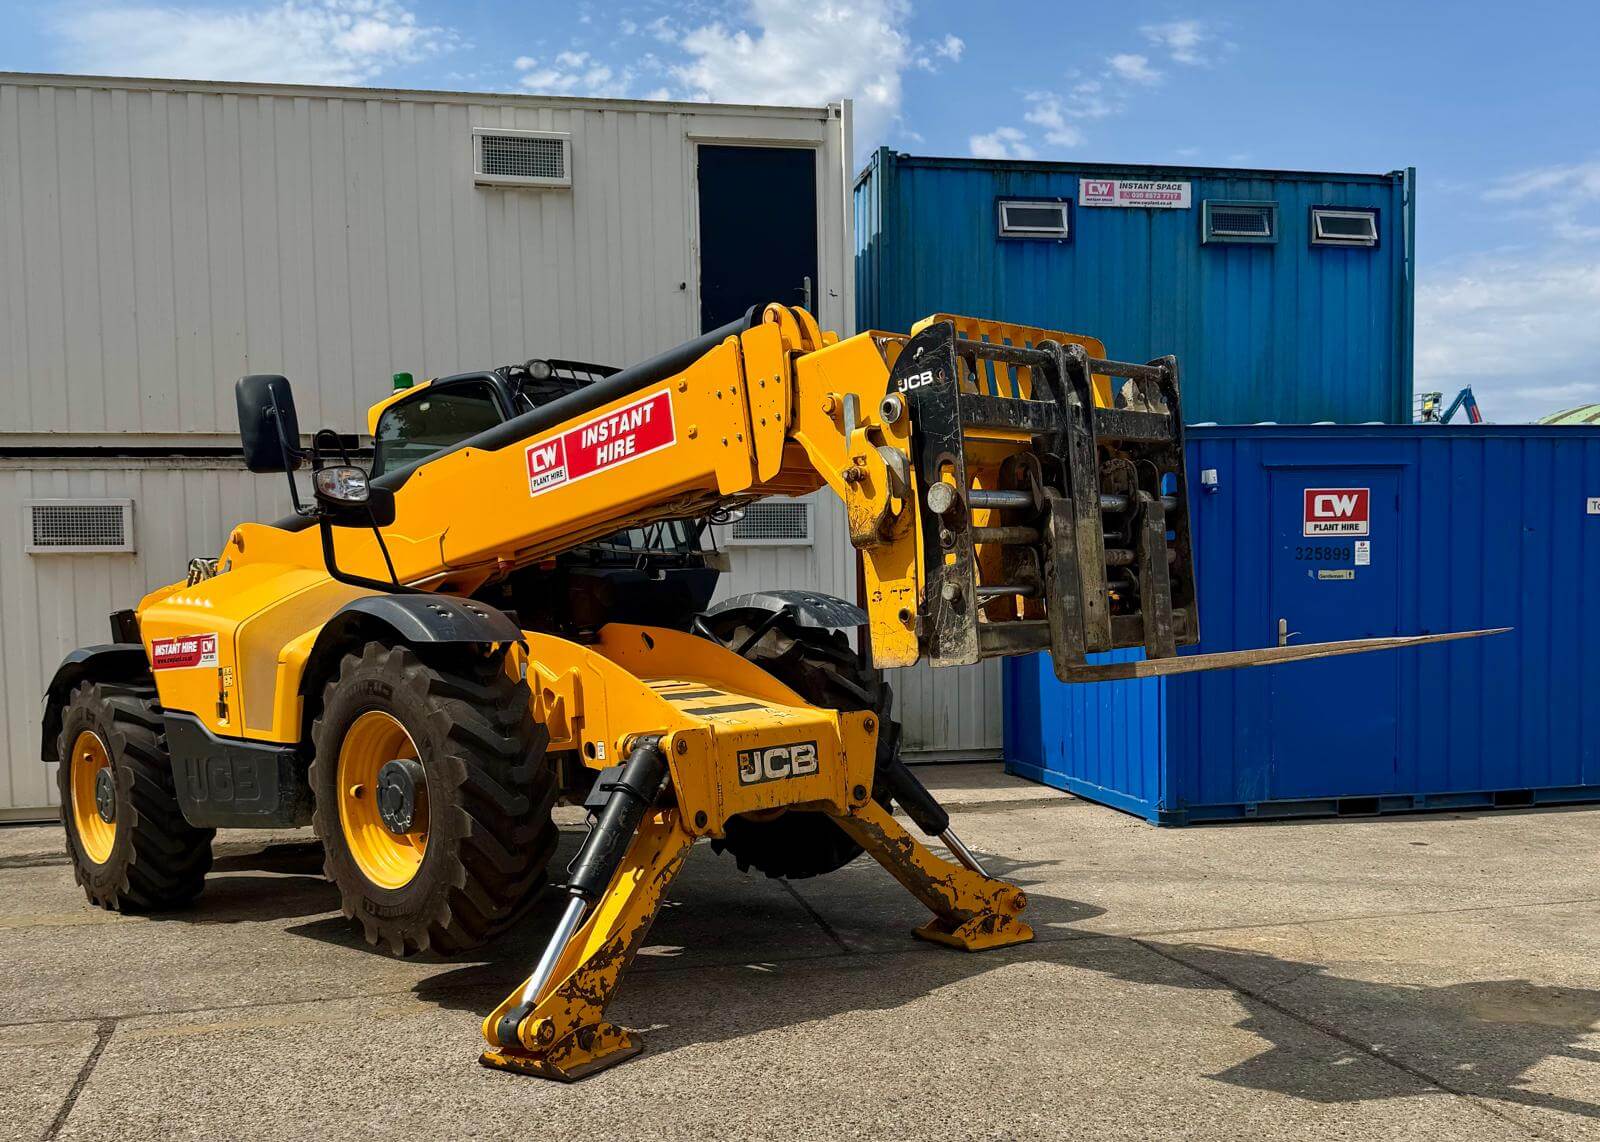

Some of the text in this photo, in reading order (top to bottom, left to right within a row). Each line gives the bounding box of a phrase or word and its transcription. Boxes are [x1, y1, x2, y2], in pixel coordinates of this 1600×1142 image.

[1088, 183, 1111, 195] CW
[1119, 182, 1183, 191] INSTANT SPACE
[898, 370, 933, 393] JCB
[581, 402, 654, 449] INSTANT
[531, 443, 557, 472] CW
[596, 433, 636, 466] HIRE
[533, 470, 564, 487] PLANT HIRE
[1314, 494, 1359, 517] CW
[1313, 523, 1361, 531] PLANT HIRE
[1295, 547, 1350, 560] 325899
[155, 641, 198, 656] INSTANT HIRE
[202, 640, 214, 653] CW
[740, 744, 818, 782] JCB
